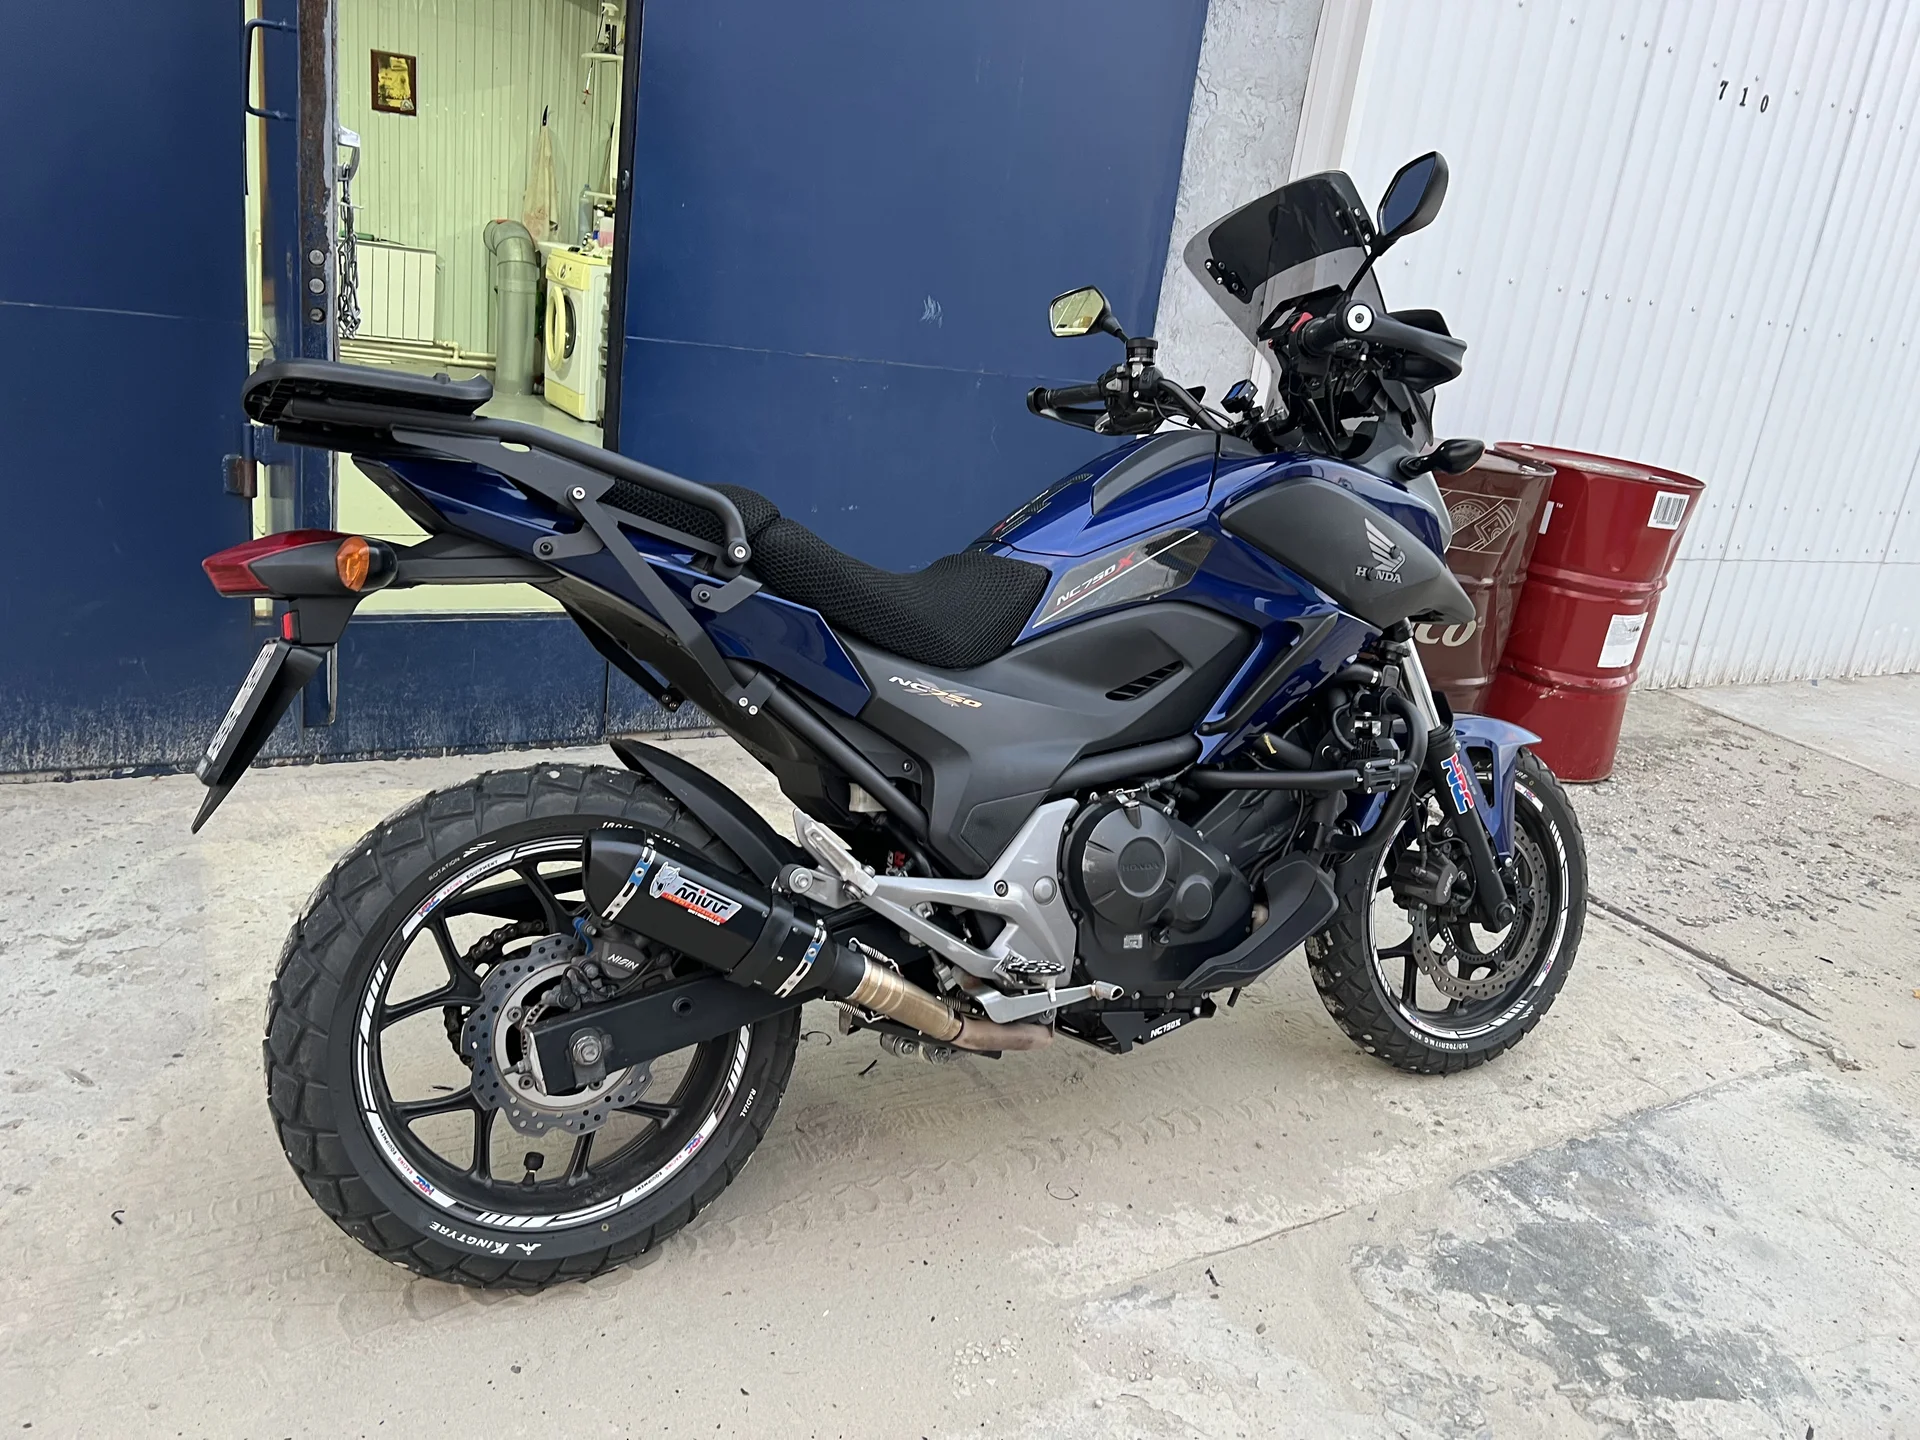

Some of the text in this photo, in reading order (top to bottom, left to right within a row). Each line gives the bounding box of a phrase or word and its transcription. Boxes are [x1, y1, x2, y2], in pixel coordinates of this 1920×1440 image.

[1355, 566, 1402, 584] HNDA
[1441, 752, 1475, 815] HRC
[428, 857, 461, 881] ROTATION
[465, 859, 499, 880] EQUIPMENT
[739, 1087, 757, 1118] RADIAL
